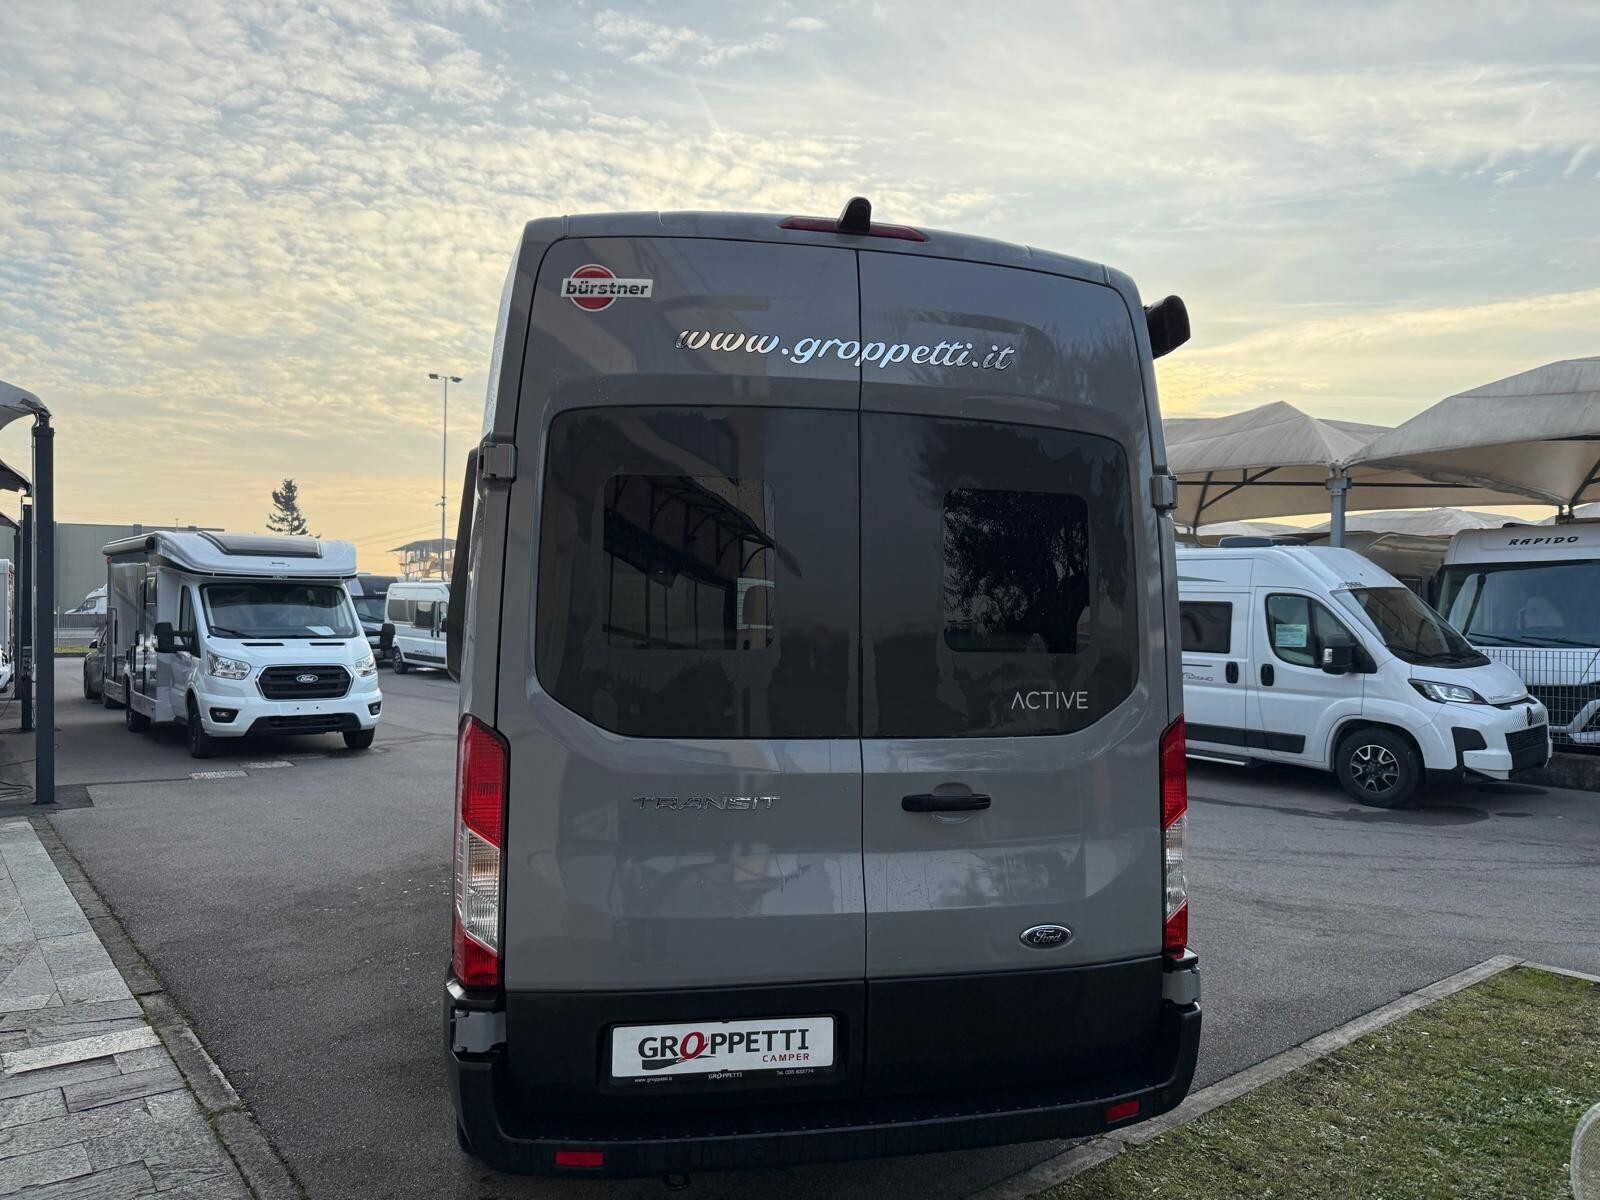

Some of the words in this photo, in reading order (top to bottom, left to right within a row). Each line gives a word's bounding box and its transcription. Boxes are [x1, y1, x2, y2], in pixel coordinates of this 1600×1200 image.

[566, 280, 648, 295] bürstner
[675, 330, 1015, 370] www.groppetti.it
[1508, 536, 1579, 546] RAPIDO
[1011, 691, 1088, 709] ACTIVE
[632, 796, 781, 810] TRANSIT
[638, 1028, 810, 1060] GROPPETTI
[762, 1052, 810, 1063] CAMPER
